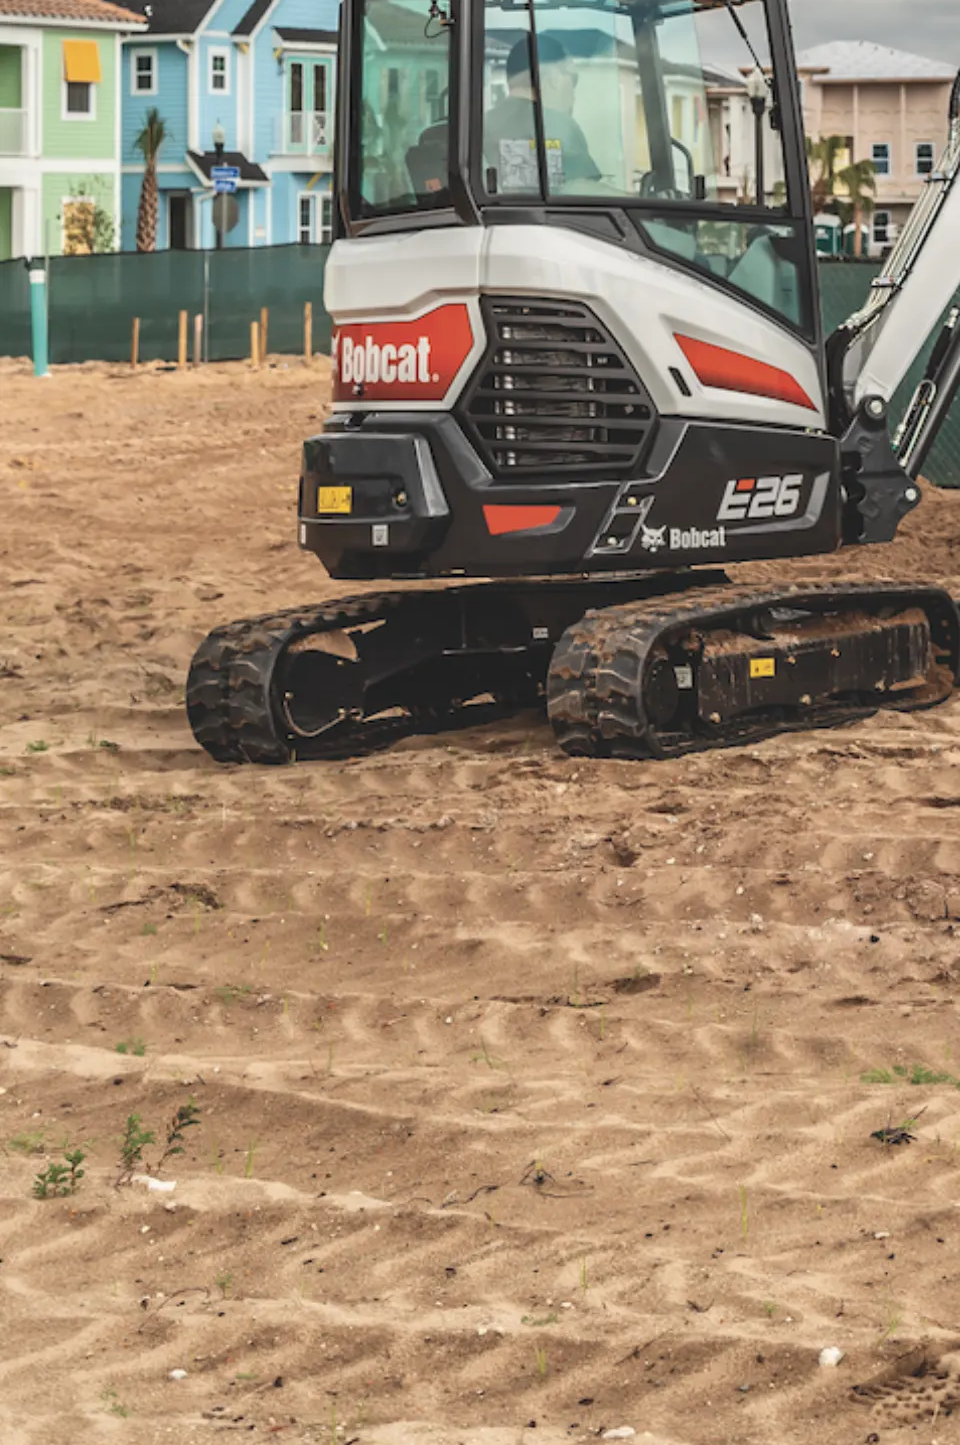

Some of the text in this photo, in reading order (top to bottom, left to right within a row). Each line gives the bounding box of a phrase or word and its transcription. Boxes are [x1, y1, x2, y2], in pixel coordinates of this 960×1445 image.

[341, 336, 431, 383] Bobcat
[716, 474, 803, 521] E26
[669, 526, 726, 550] Bobcat
